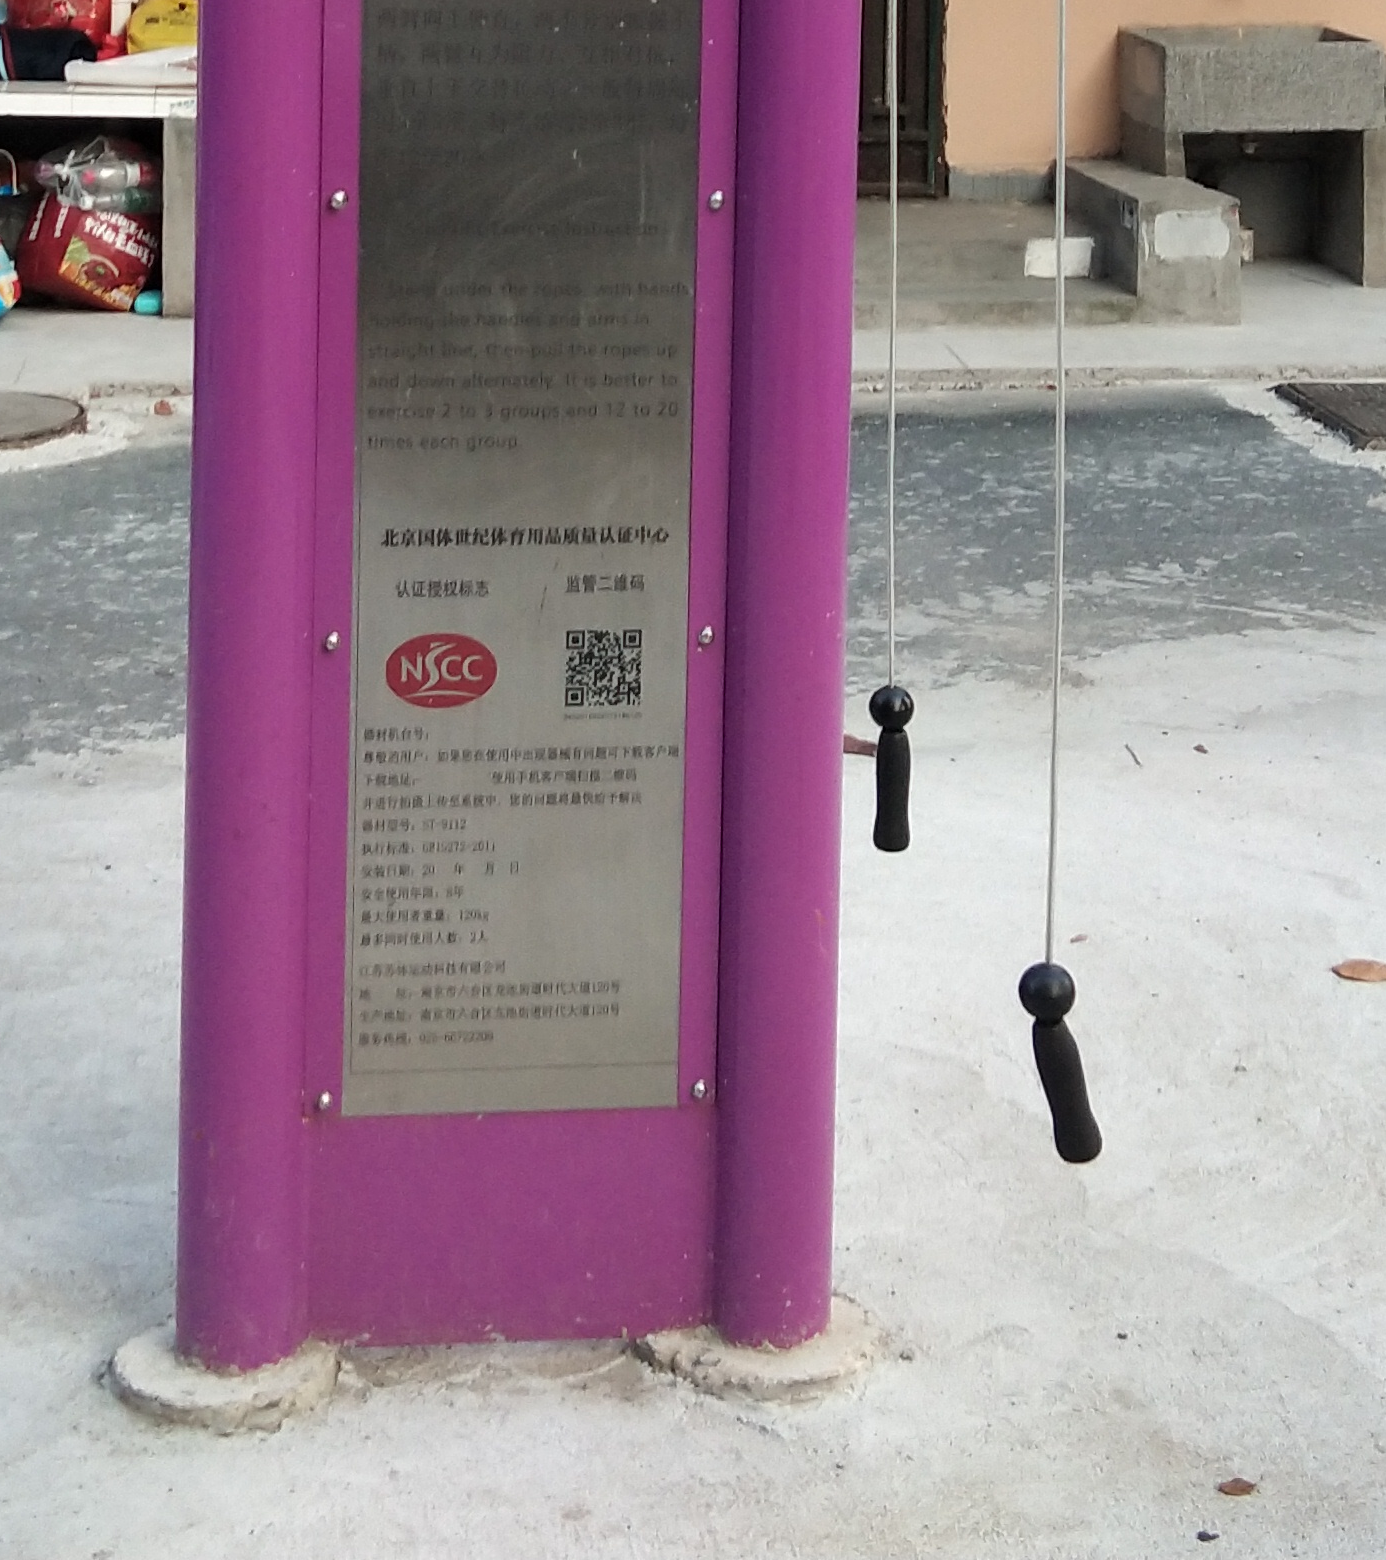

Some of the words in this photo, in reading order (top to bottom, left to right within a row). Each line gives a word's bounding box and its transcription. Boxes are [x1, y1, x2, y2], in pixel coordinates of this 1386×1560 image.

[366, 372, 400, 390] and
[407, 372, 456, 390] down
[602, 371, 655, 389] better
[660, 372, 679, 389] to
[366, 404, 436, 422] exercise
[441, 402, 452, 420] 2
[459, 402, 477, 420] to
[499, 404, 561, 423] groups
[565, 401, 599, 419] and
[605, 400, 627, 418] 12
[633, 401, 651, 418] to
[656, 400, 679, 418] 20
[366, 433, 414, 451] times
[418, 433, 460, 450] each
[380, 525, 670, 548] 北京国体世纪体育用品质量认证中心
[395, 579, 490, 599] 认证授权标志
[565, 574, 645, 594] 监管二维码
